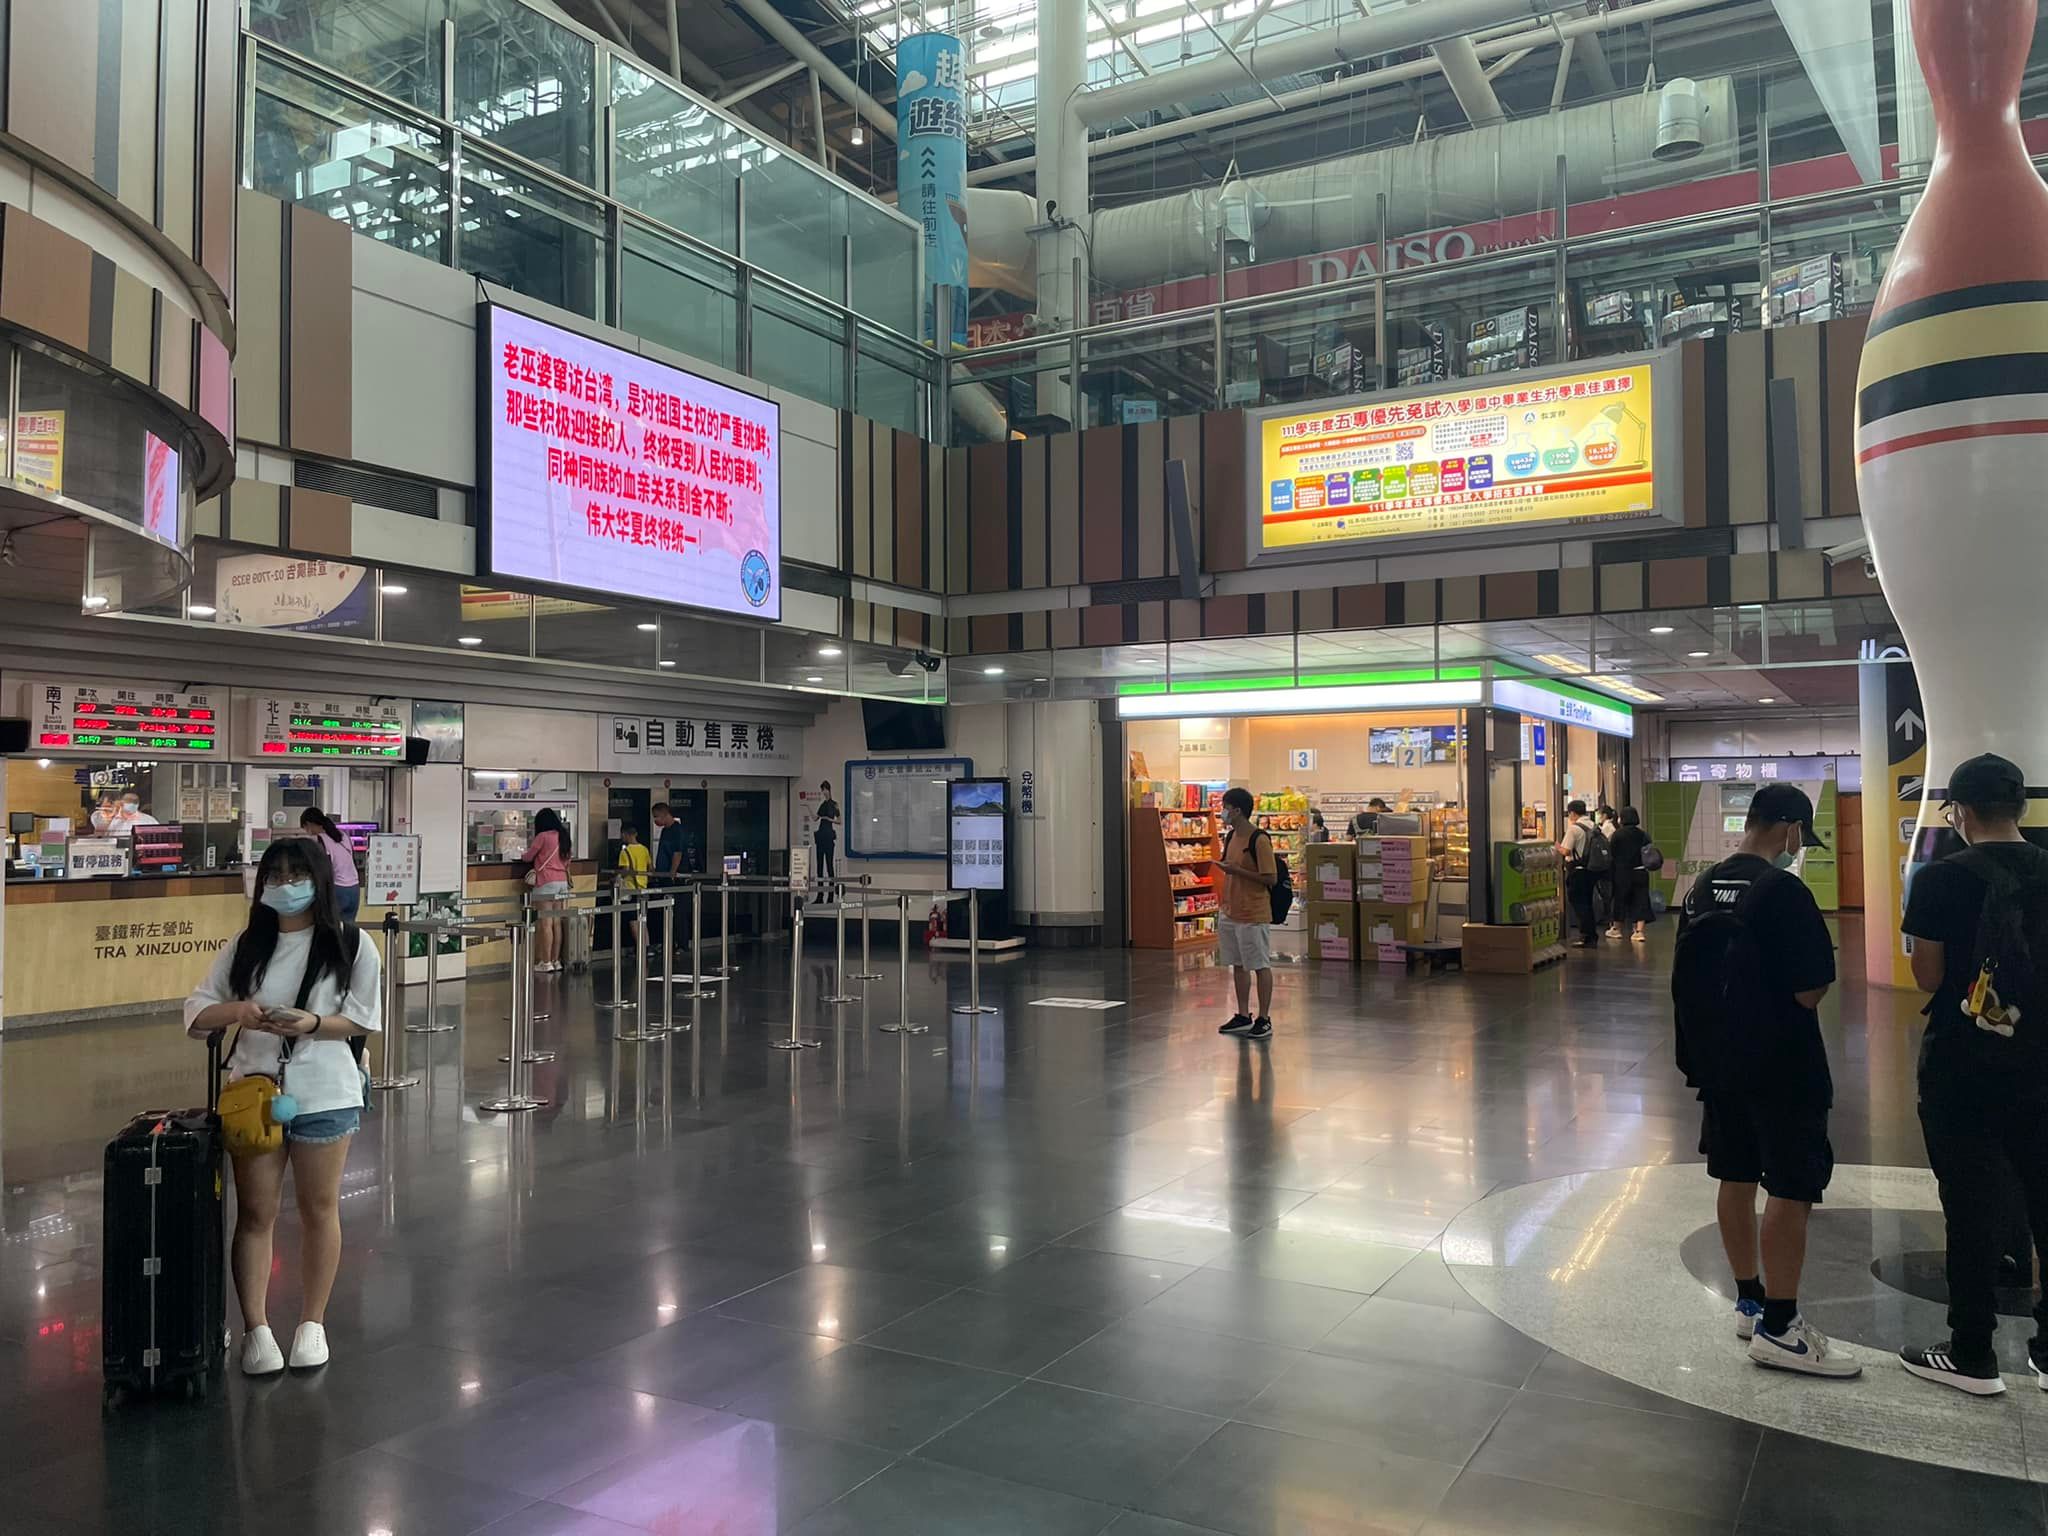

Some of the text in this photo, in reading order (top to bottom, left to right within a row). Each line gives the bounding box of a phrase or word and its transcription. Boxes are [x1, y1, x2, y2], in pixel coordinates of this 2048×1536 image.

[1307, 231, 1476, 285] DAISO
[1352, 348, 1363, 395] DAIS
[645, 718, 775, 752] 自動售票機
[1298, 751, 1309, 769] 3
[1404, 749, 1415, 766] 2
[1709, 762, 1778, 779] 寄物櫃
[72, 854, 123, 870] 暫停服務
[95, 919, 194, 942] 臺鐵新左營站
[94, 945, 128, 959] TRA
